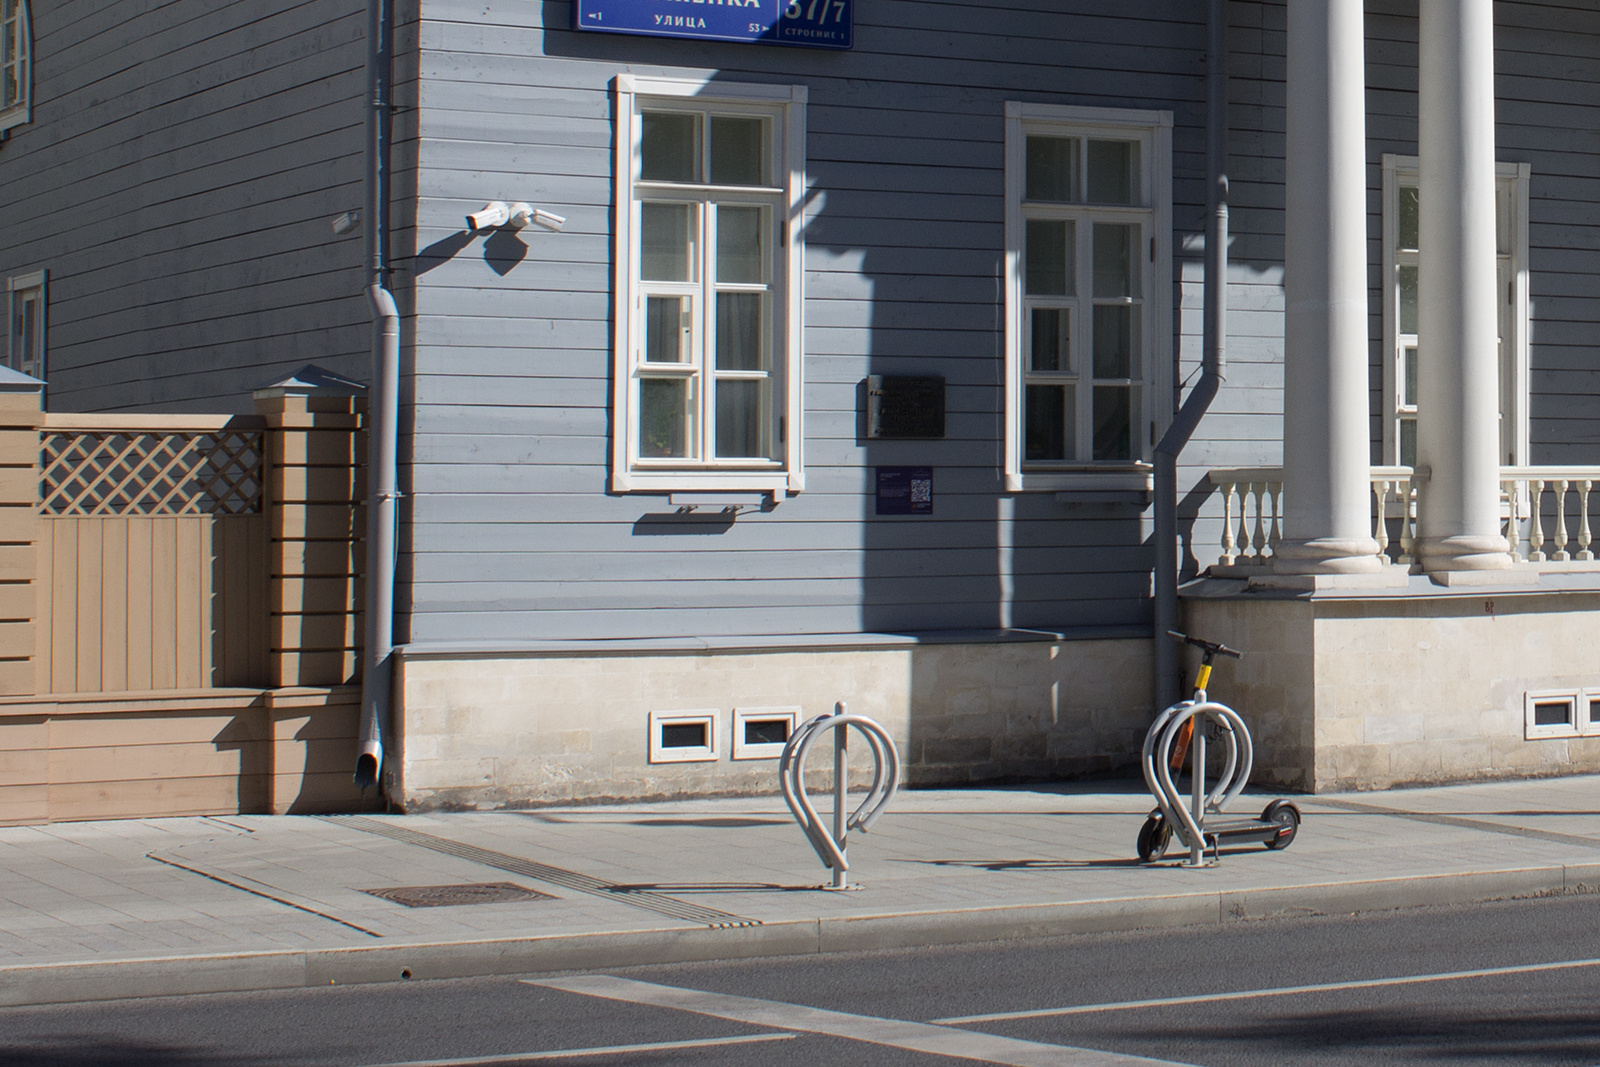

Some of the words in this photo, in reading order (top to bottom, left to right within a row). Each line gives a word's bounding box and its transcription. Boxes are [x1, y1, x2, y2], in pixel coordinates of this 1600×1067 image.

[654, 14, 707, 29] УЛИЦА
[748, 22, 761, 34] 53
[785, 27, 837, 40] СТРОЕНИЕ
